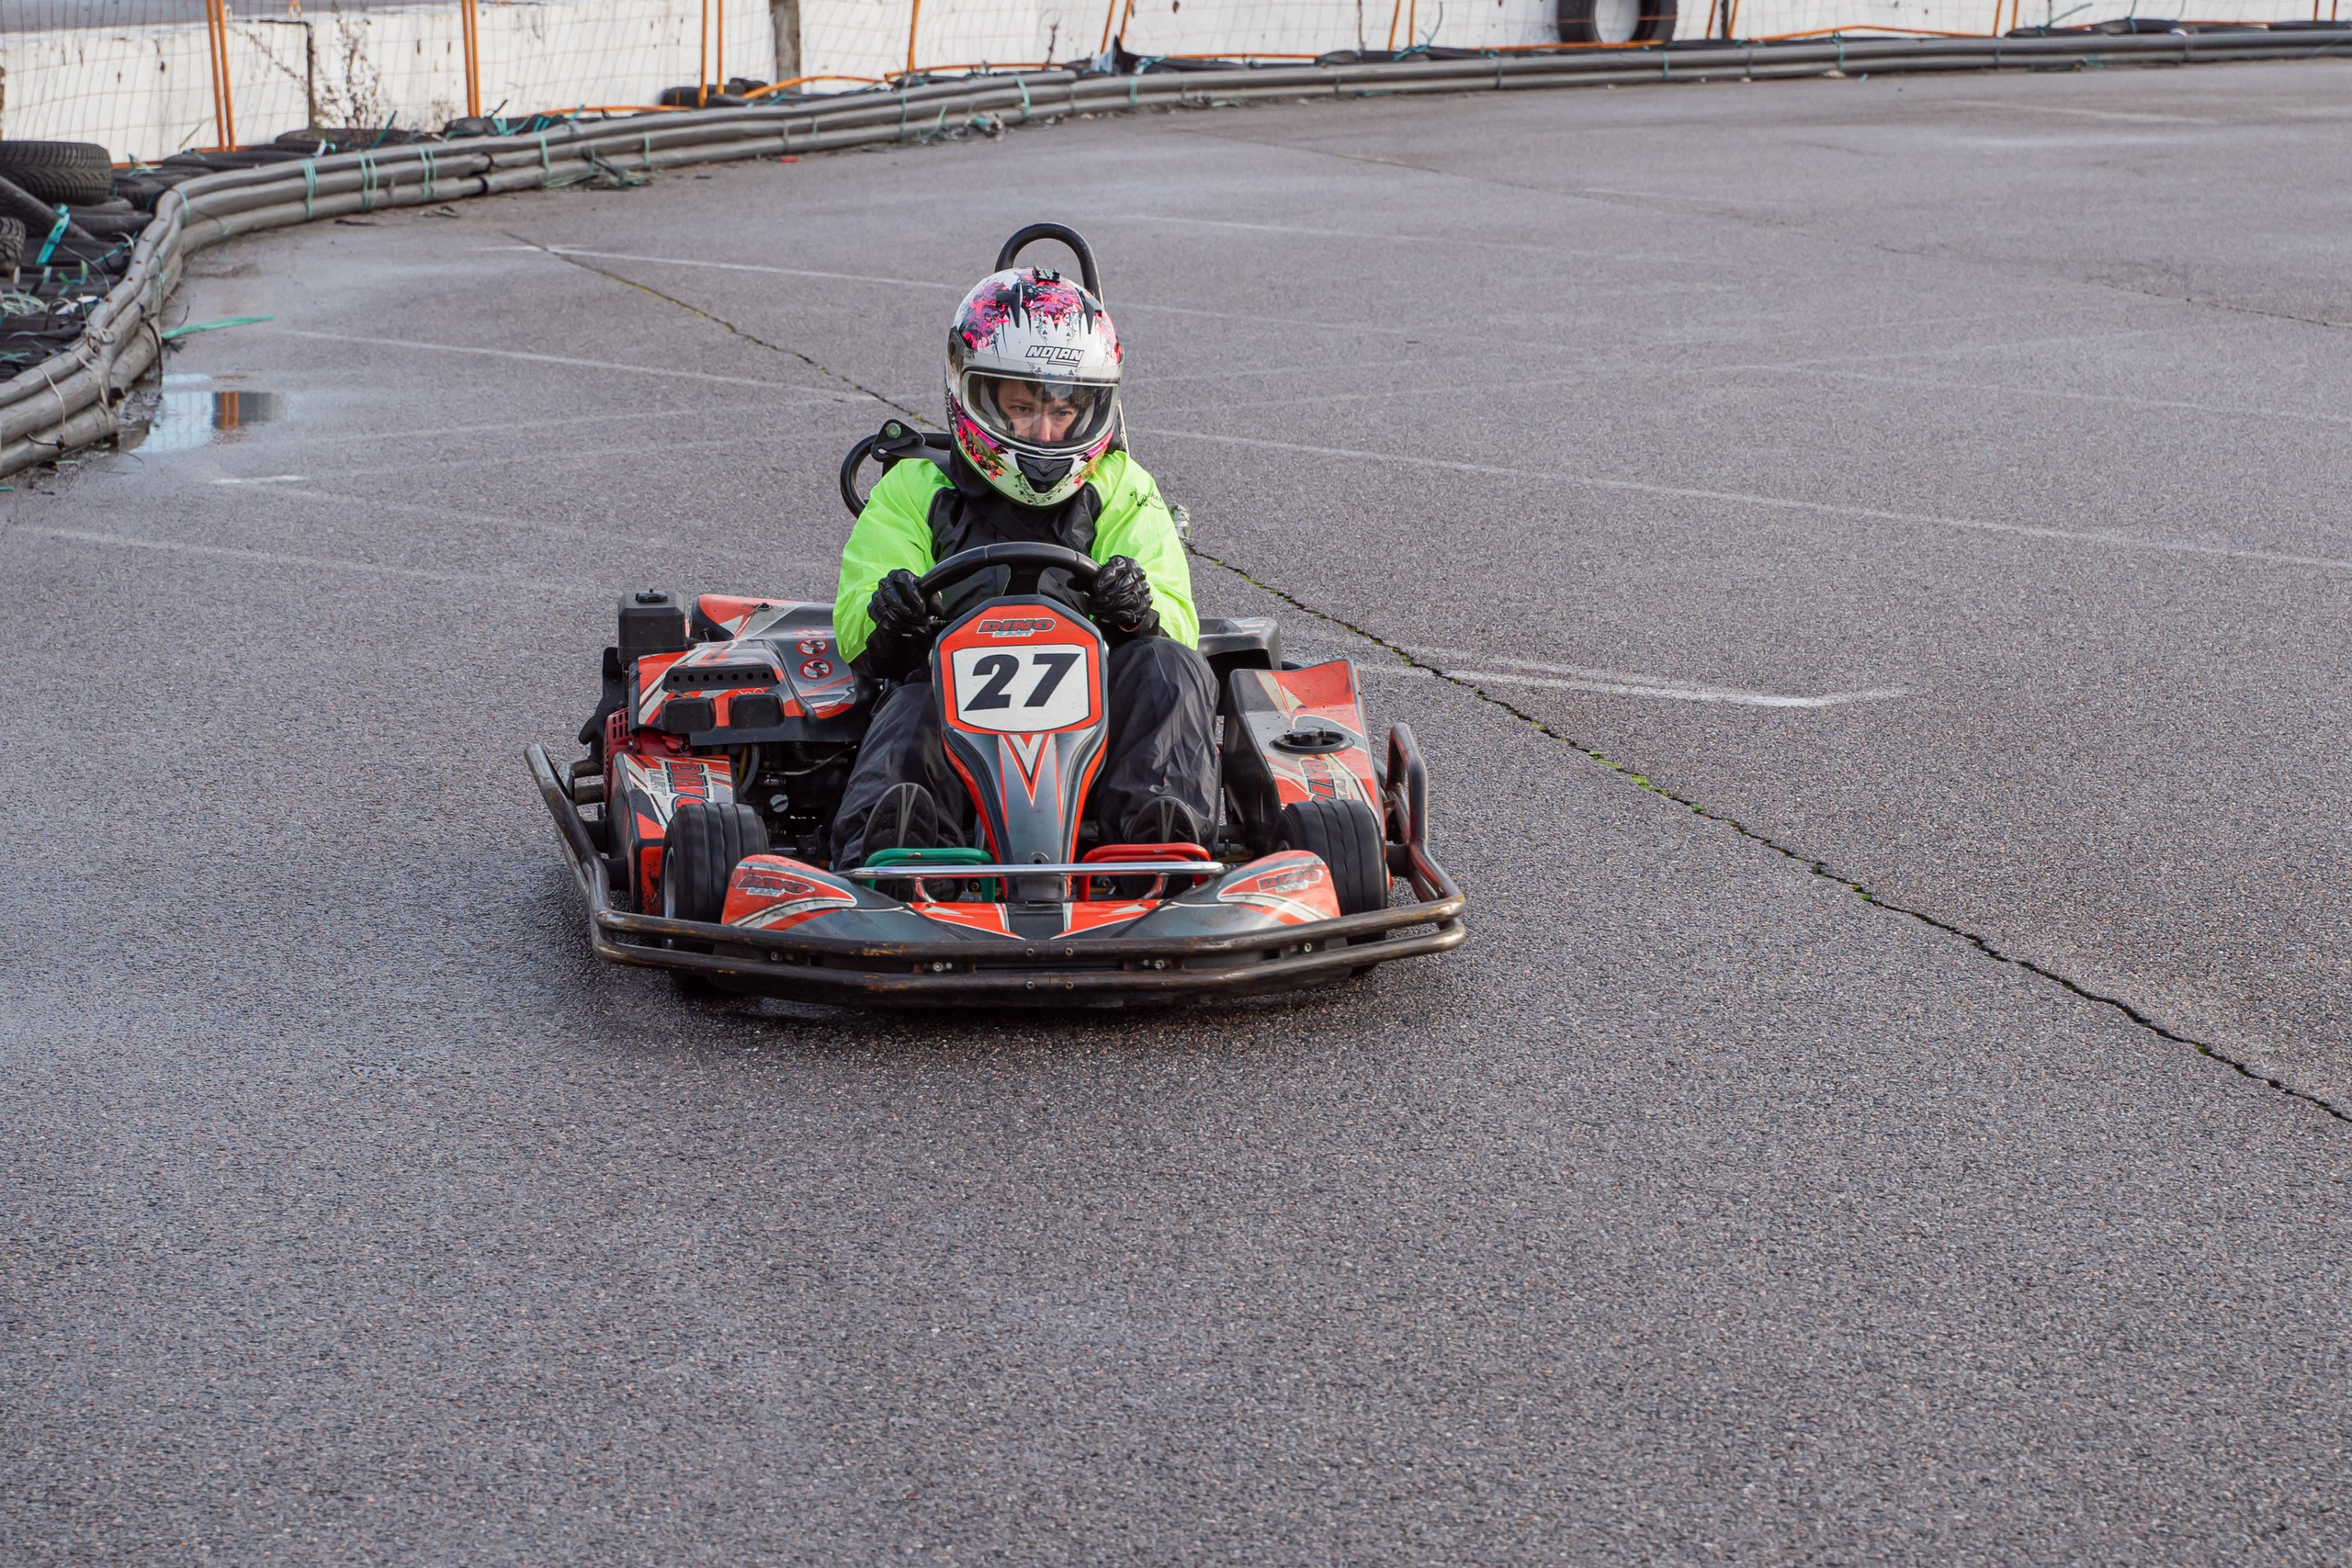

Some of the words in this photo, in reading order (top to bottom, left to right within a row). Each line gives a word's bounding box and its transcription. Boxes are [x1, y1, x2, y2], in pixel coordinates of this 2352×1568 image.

[1025, 344, 1084, 367] NOLAN
[978, 618, 1055, 633] DINO
[963, 653, 1081, 712] 27
[737, 875, 810, 894] DINO
